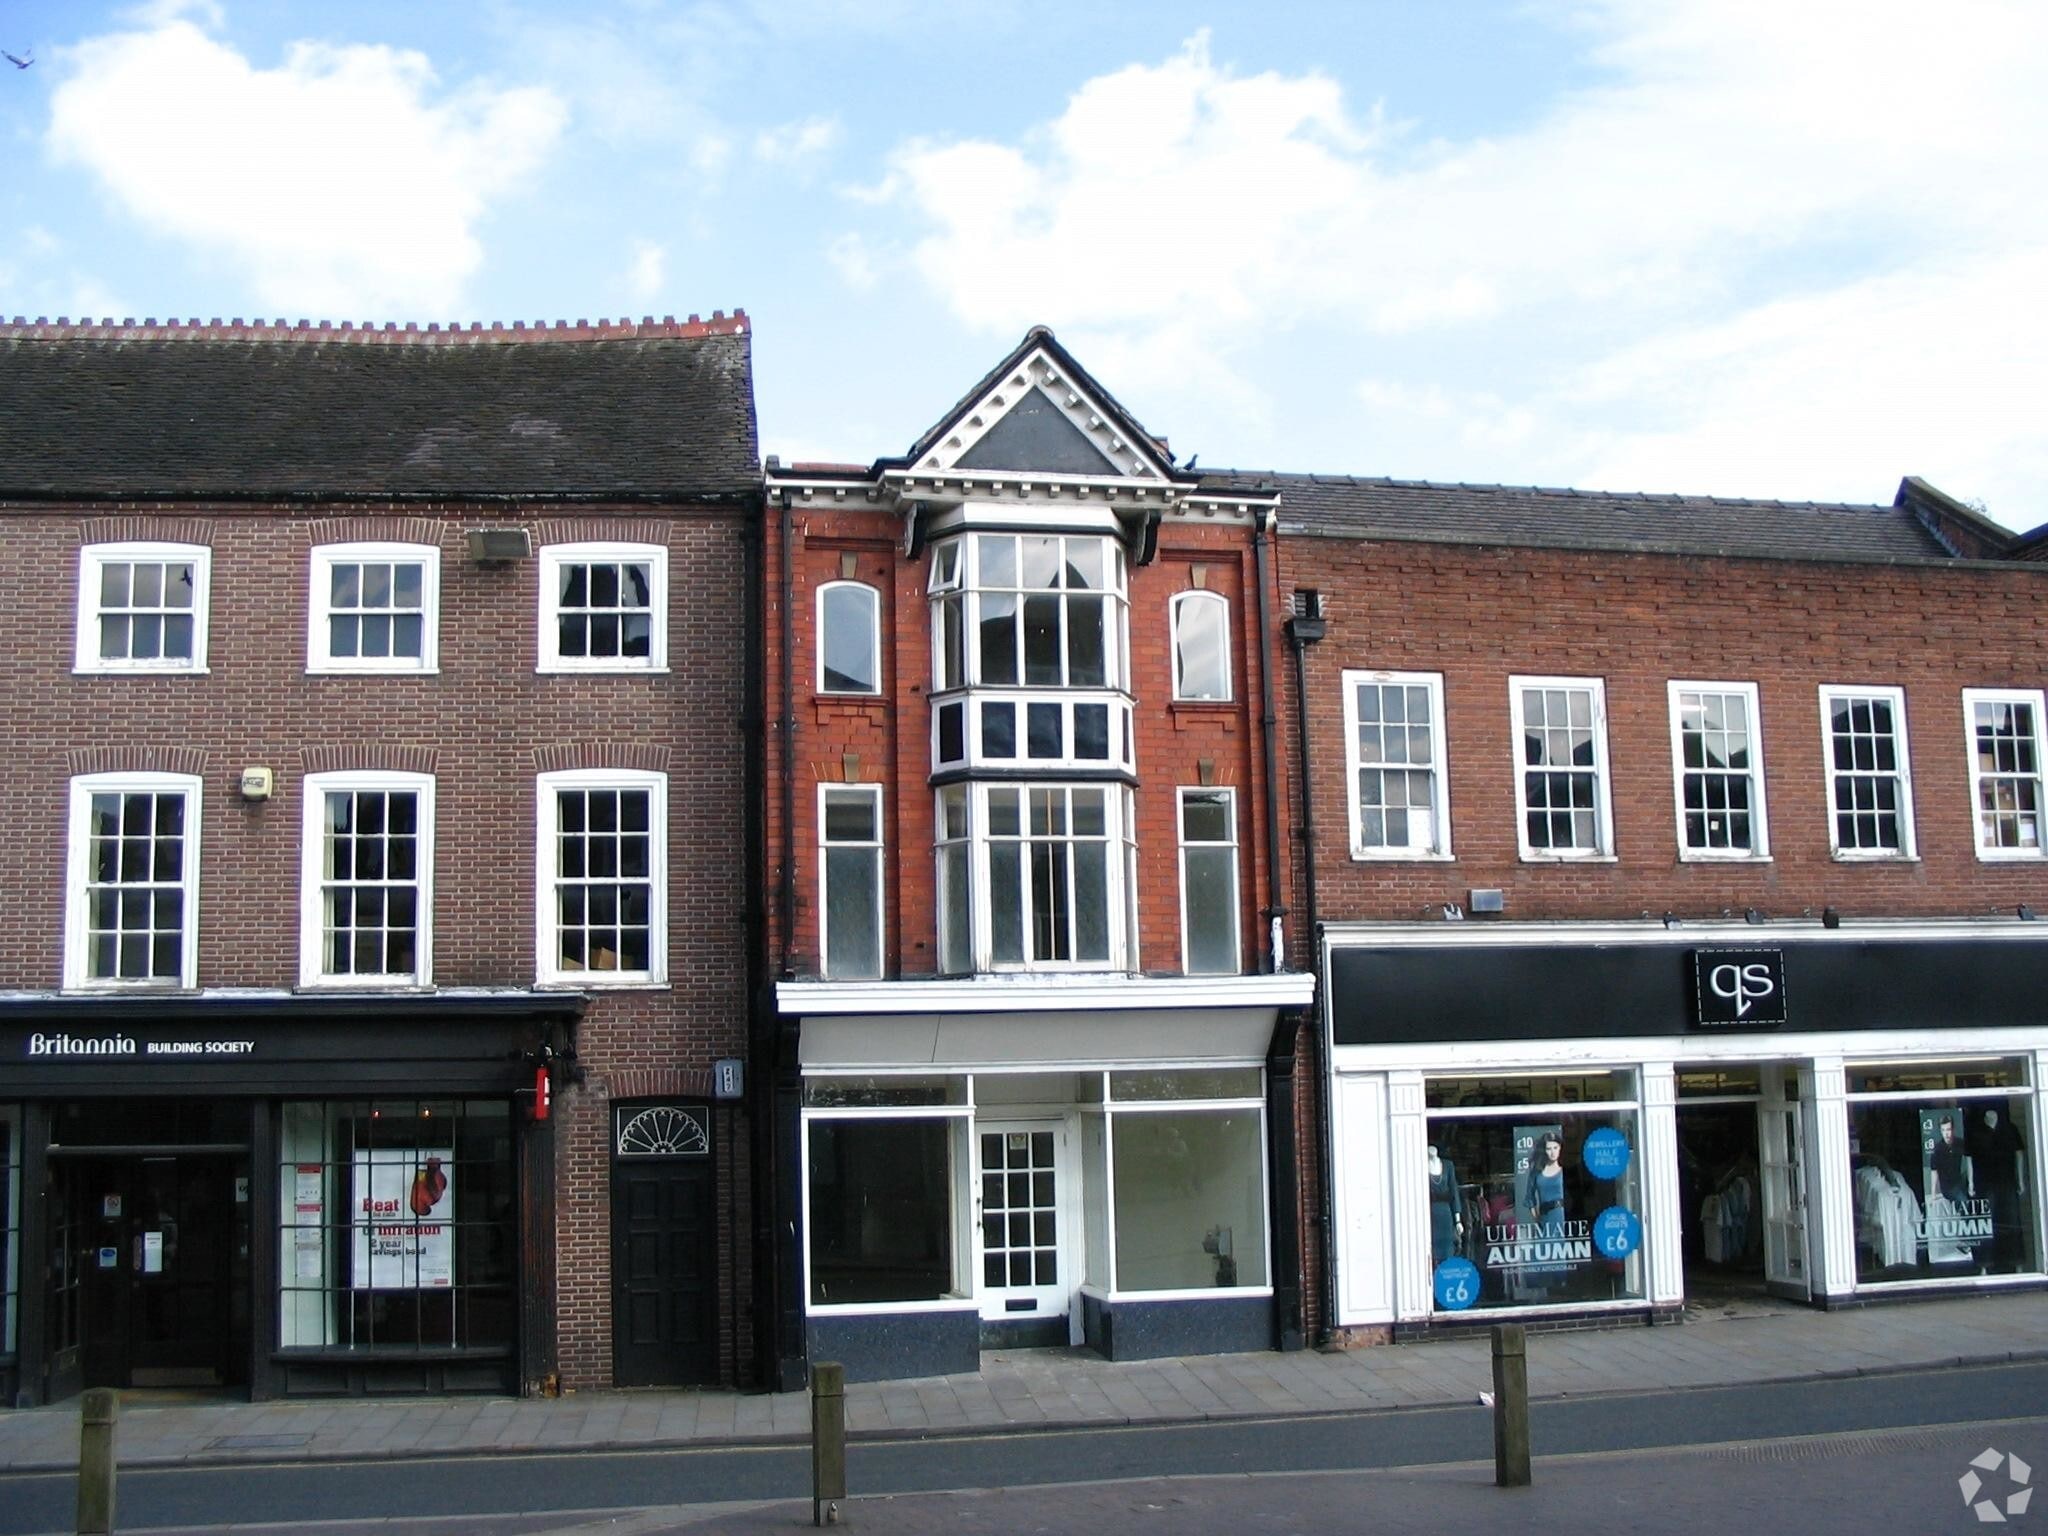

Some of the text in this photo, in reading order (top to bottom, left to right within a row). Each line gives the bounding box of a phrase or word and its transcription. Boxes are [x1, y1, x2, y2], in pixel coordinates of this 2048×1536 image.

[1710, 964, 1774, 1017] qs
[29, 1033, 254, 1054] Britannia BUILDING SOCIETY
[1486, 1220, 1590, 1242] ULTIMATE
[1606, 1229, 1629, 1251] £6
[1487, 1241, 1592, 1265] AUTUMN
[1445, 1279, 1469, 1302] £6
